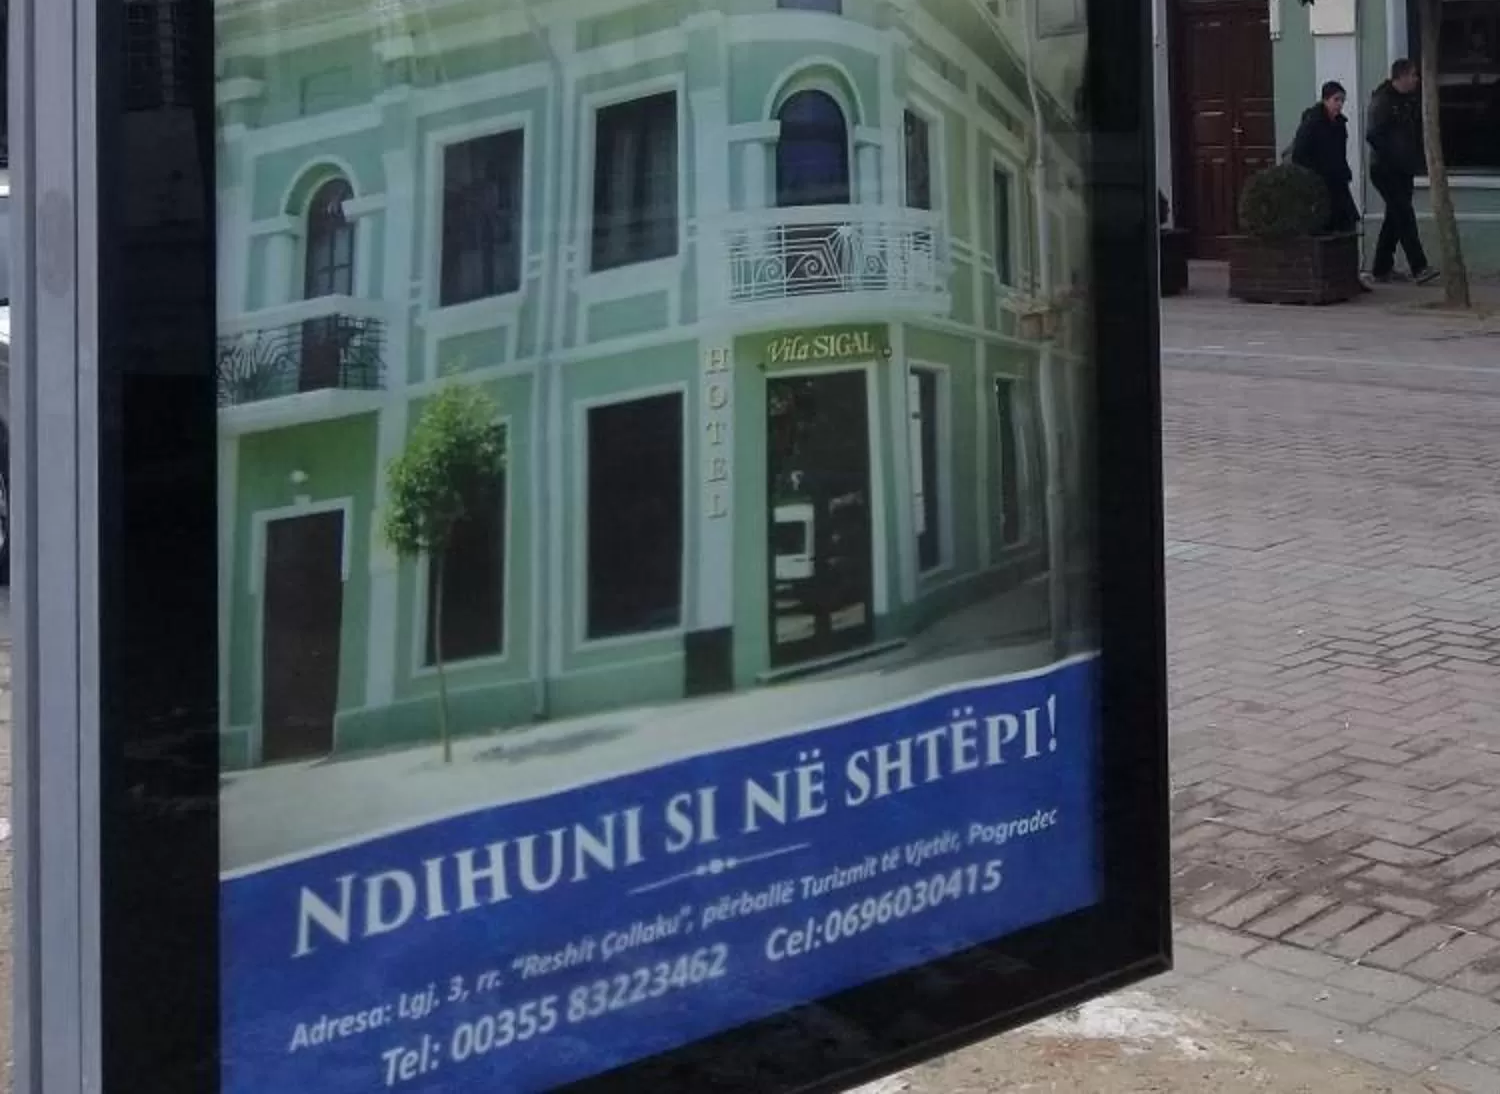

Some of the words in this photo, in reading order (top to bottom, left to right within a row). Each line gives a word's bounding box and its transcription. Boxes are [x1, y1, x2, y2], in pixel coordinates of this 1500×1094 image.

[766, 335, 811, 364] Vila
[811, 330, 876, 360] SIGAL
[290, 806, 646, 959] NDIHUNI
[664, 784, 721, 854] SI
[741, 746, 828, 834] NË
[844, 692, 1058, 808] SHTËPI!
[288, 1002, 393, 1053] Adresa:
[446, 974, 470, 1004] 3,
[701, 879, 796, 930] përballë
[798, 853, 879, 901] Turizmit
[881, 844, 902, 874] të
[966, 806, 1059, 847] Pogradec
[380, 1033, 441, 1088] Tel:
[450, 994, 560, 1064] 00355
[565, 941, 730, 1024] 83223462
